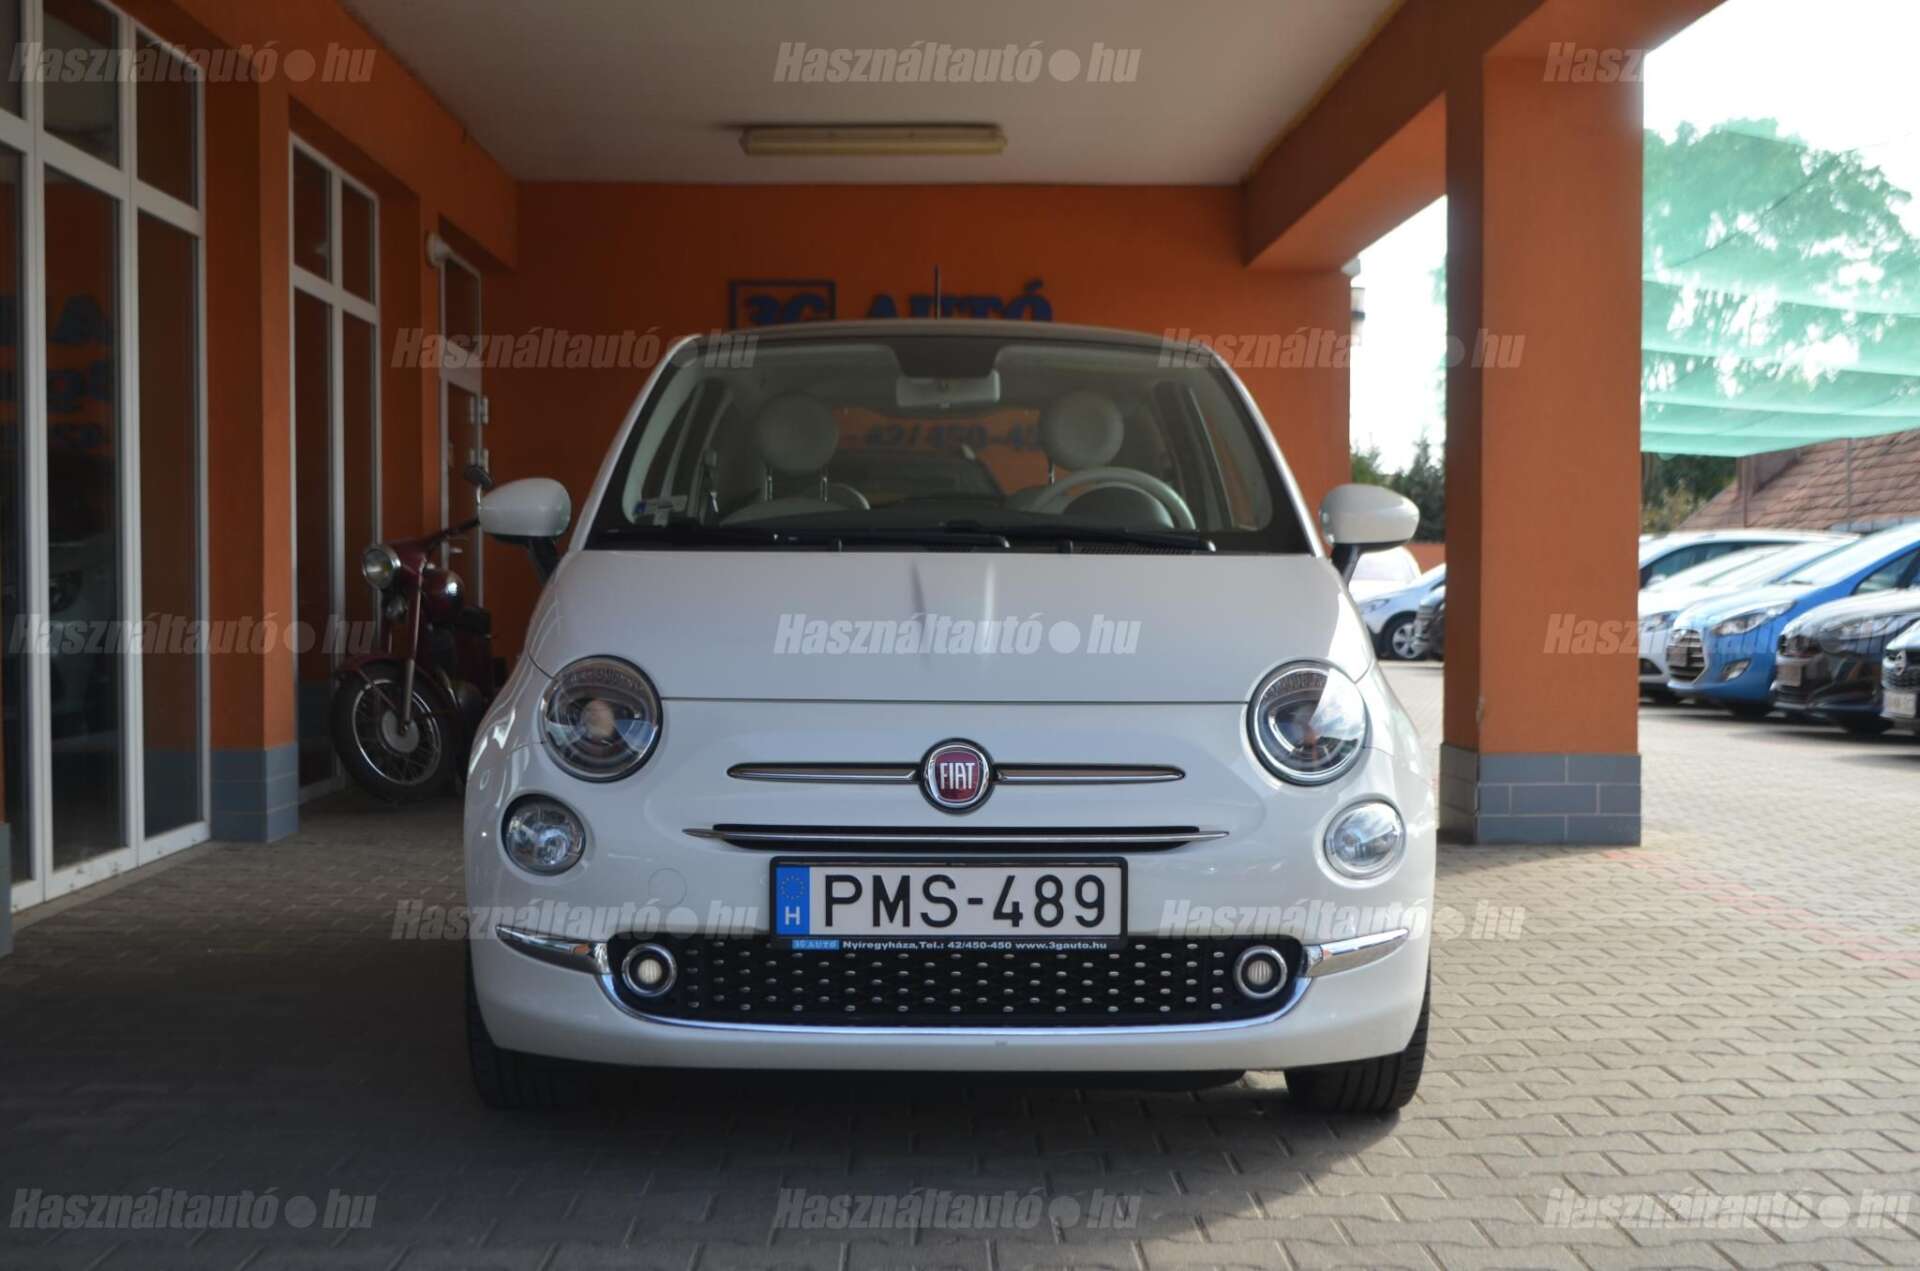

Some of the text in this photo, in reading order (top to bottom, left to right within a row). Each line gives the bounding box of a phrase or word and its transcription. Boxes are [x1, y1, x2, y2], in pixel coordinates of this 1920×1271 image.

[940, 762, 976, 790] FIAT
[784, 873, 1106, 929] H PMS-489
[947, 940, 1012, 950] 42/450-450
[1015, 940, 1107, 951] www.3gauto.hu
